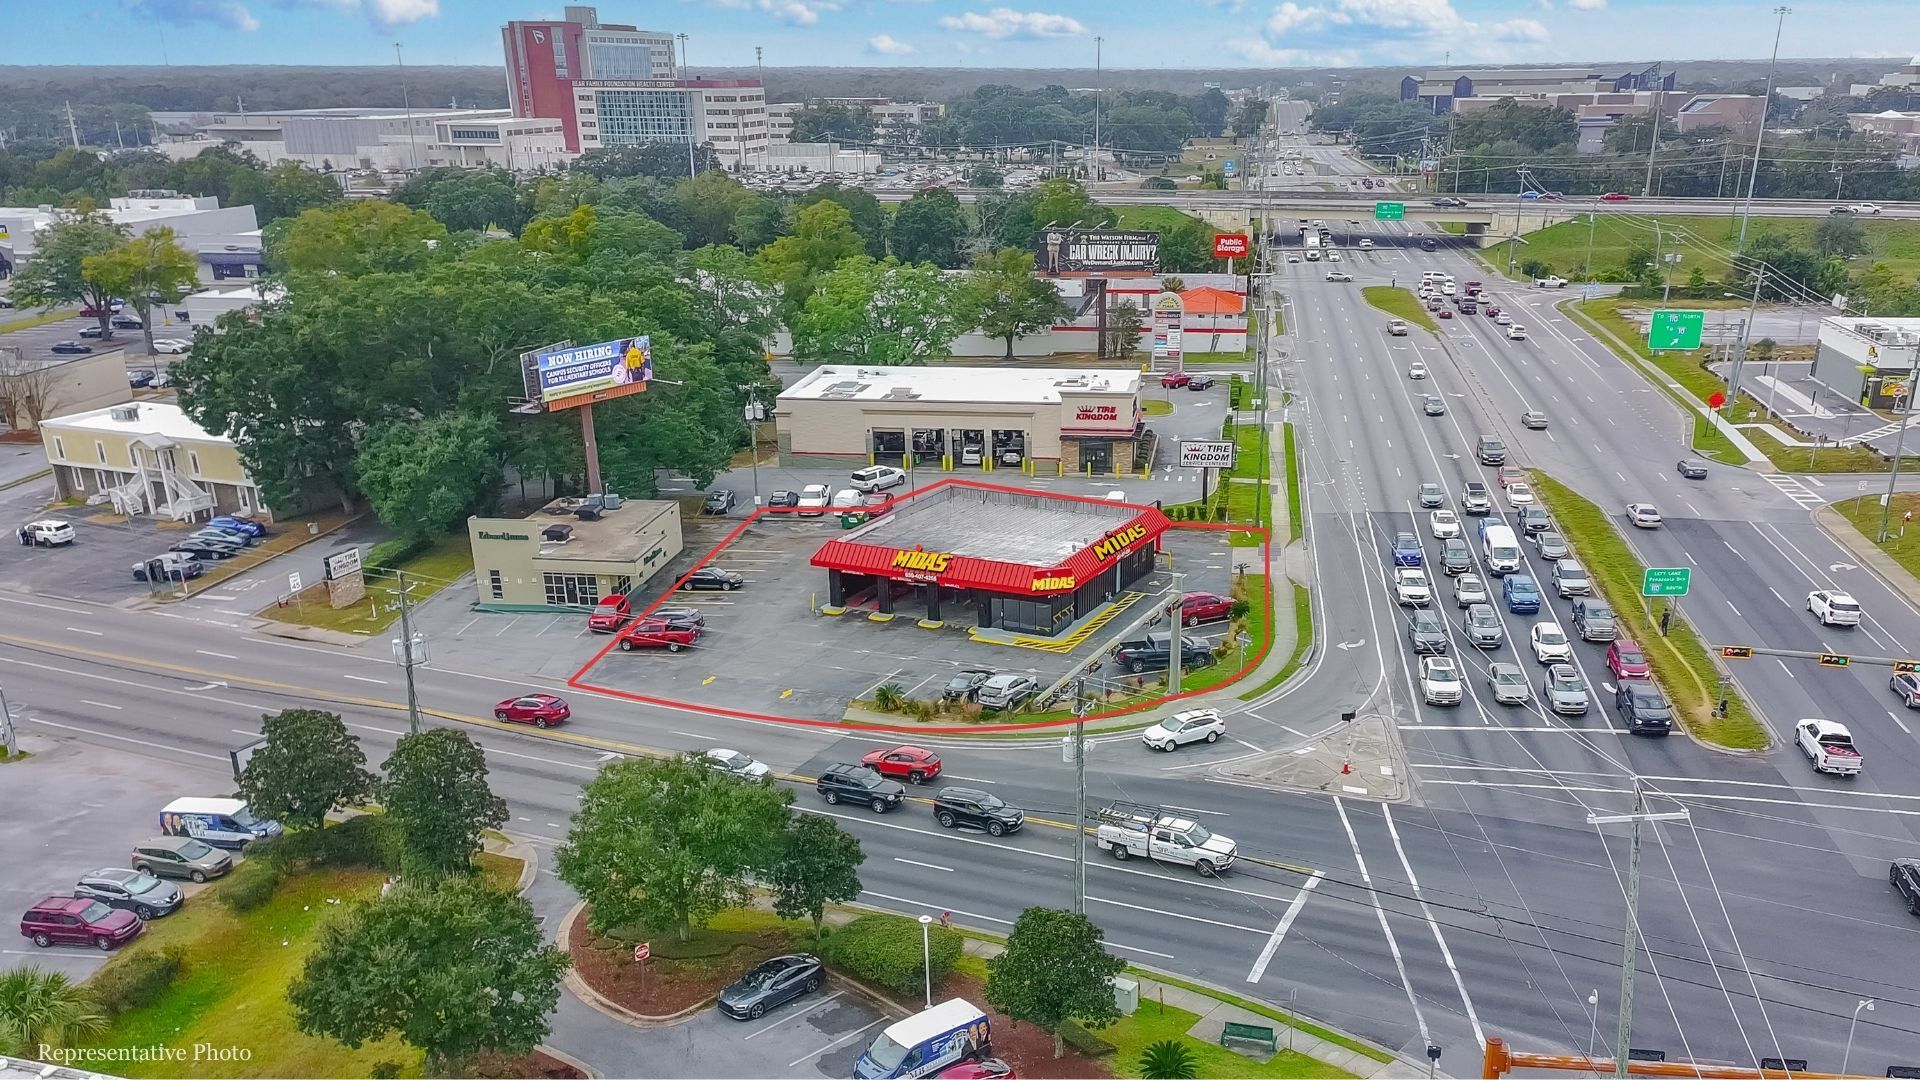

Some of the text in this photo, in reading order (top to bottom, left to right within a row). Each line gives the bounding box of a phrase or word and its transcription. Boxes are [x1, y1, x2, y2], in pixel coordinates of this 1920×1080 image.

[1216, 244, 1245, 254] Storage
[1220, 238, 1243, 246] Public
[1069, 244, 1157, 260] CAR WRECK INJURY?
[547, 346, 612, 367] NOW HIRING
[567, 363, 590, 374] SECURITY
[590, 359, 612, 370] OFFICERS
[548, 375, 560, 385] FOR
[589, 366, 612, 377] SCHOOLS
[1075, 413, 1118, 421] KINGDOM
[1207, 444, 1230, 453] TIRE
[1183, 453, 1230, 461] KINGDOM
[1092, 523, 1148, 561] MIDAS
[344, 551, 357, 562] TIRE
[892, 548, 954, 573] MIDAS
[332, 558, 359, 573] KINGDOM
[291, 582, 301, 590] 45
[1031, 576, 1076, 592] MIDAS
